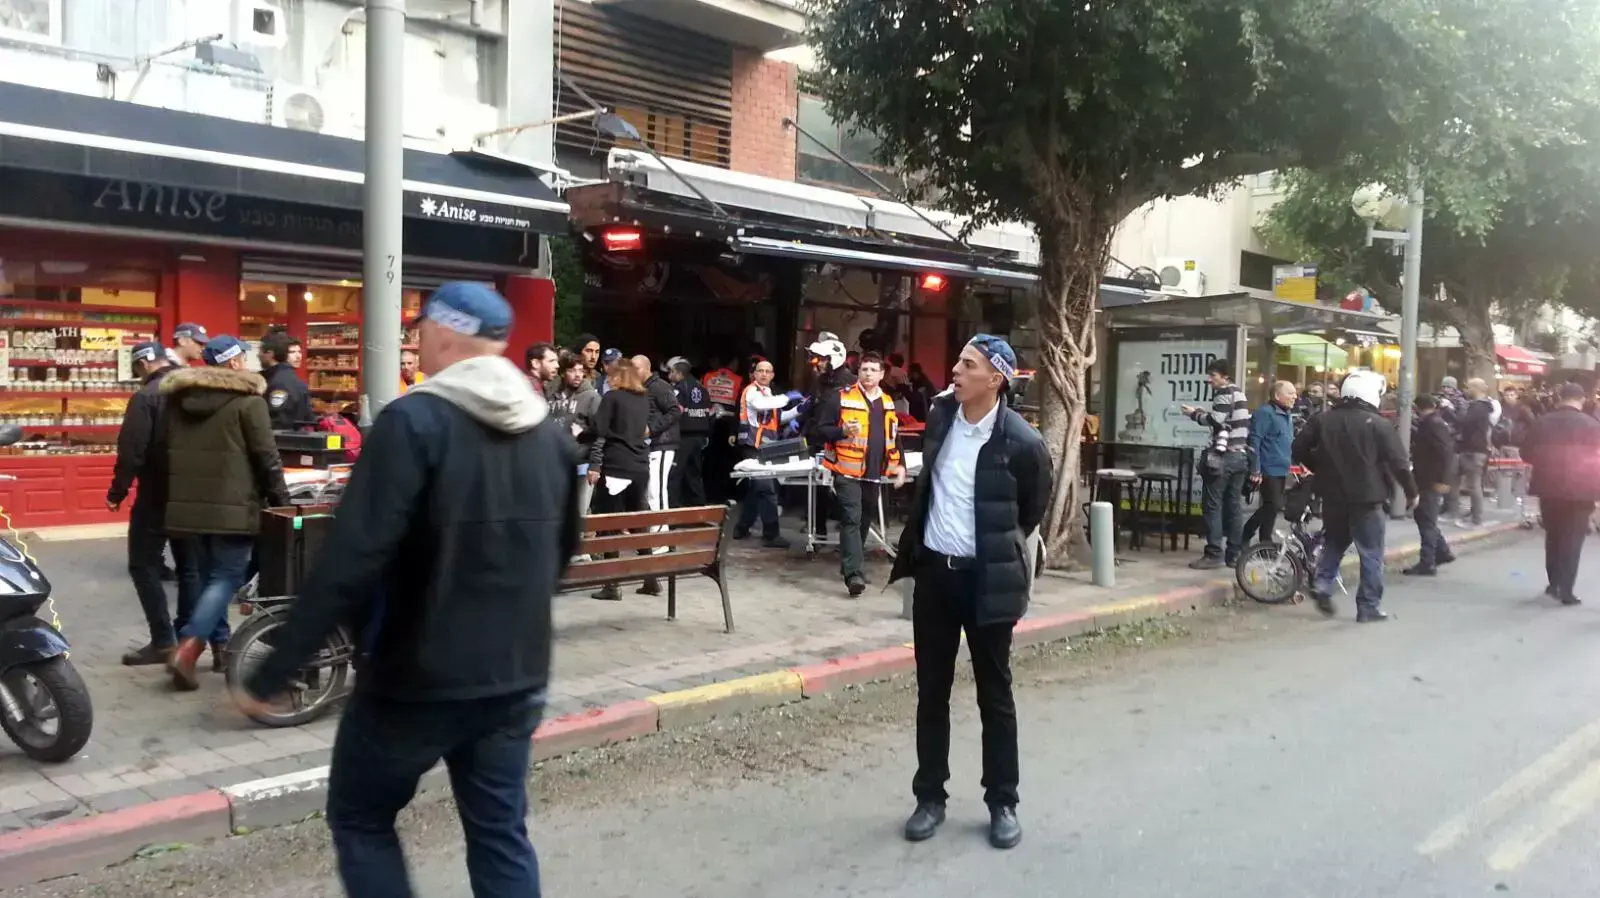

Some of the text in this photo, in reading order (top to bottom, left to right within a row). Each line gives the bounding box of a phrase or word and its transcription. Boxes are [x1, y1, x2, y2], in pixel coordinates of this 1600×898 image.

[92, 179, 228, 223] Anise
[437, 201, 477, 221] Anise
[479, 214, 495, 223] טבע
